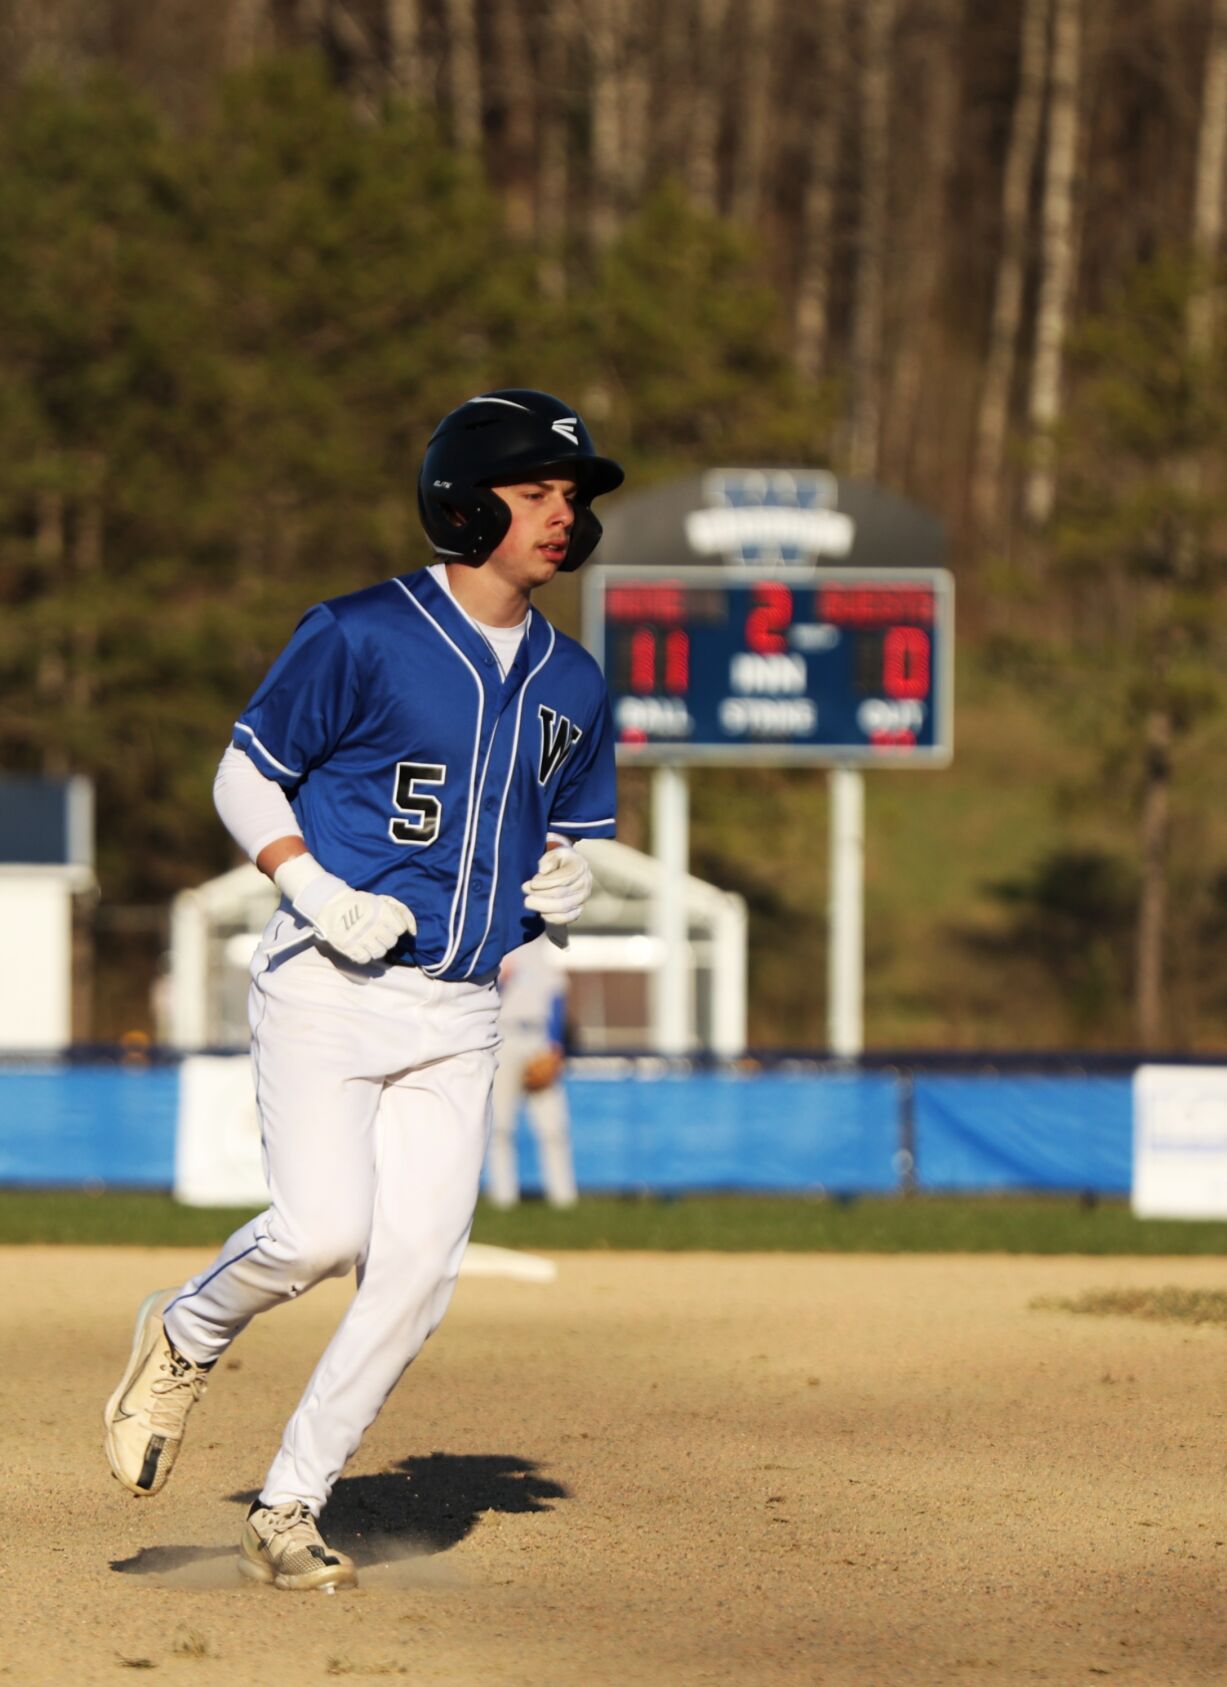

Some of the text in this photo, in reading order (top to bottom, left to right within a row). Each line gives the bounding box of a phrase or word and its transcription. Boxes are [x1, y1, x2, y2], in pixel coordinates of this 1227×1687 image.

[746, 582, 793, 653] 2
[631, 628, 689, 694] 11
[884, 627, 930, 700] 0
[538, 704, 582, 786] W
[388, 762, 447, 845] 5
